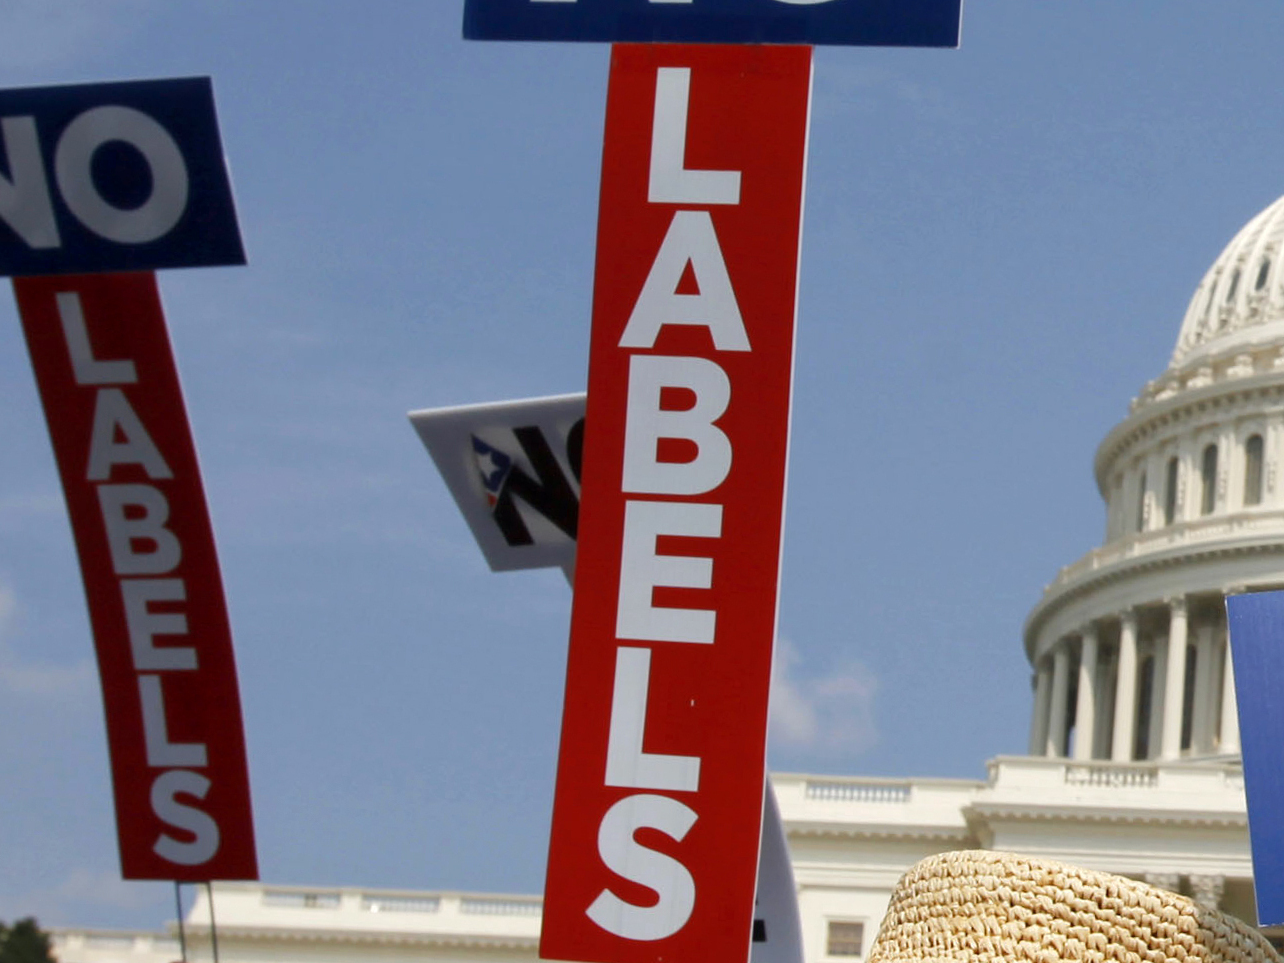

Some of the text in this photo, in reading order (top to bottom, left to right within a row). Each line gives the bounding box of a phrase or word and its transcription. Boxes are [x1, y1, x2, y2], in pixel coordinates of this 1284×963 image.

[55, 291, 220, 865] LABELS
[478, 417, 585, 547] N
[585, 67, 753, 941] LABELS
